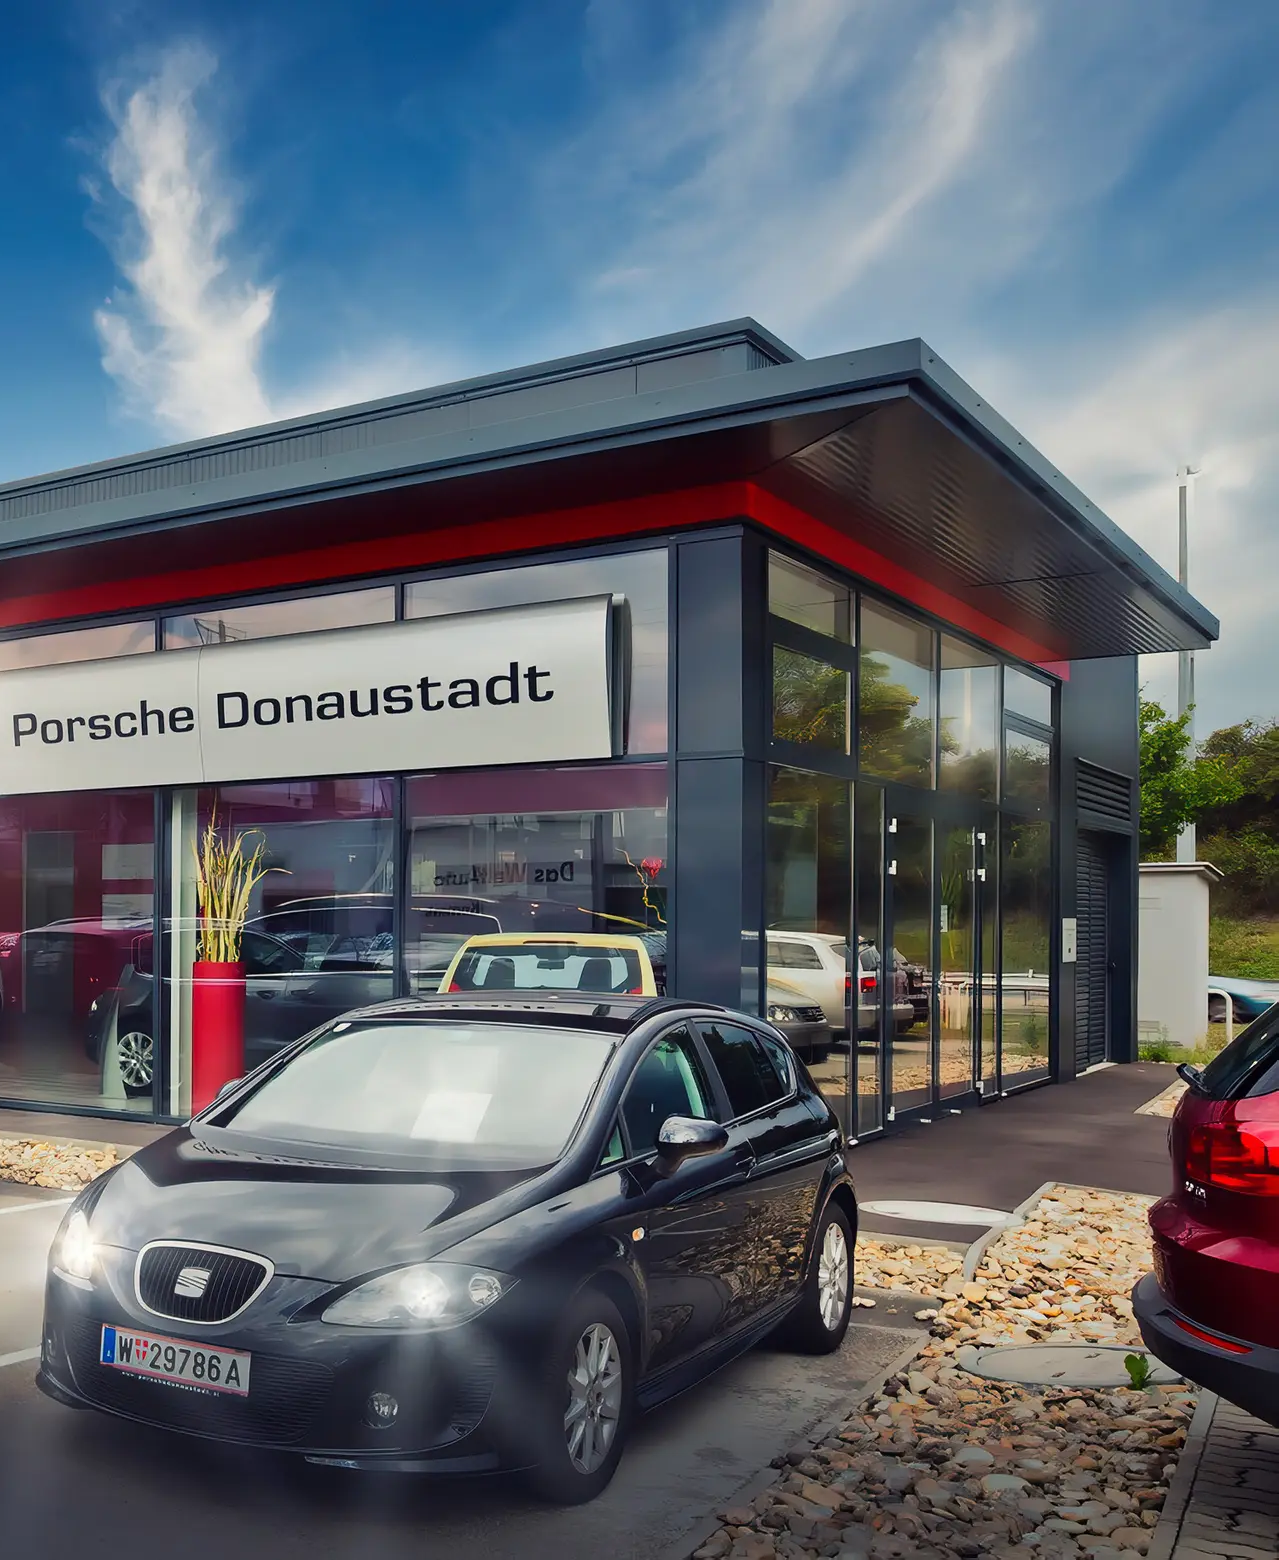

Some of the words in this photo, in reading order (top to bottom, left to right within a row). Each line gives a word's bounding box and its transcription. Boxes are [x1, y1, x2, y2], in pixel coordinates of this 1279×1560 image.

[12, 699, 196, 747] Porsche
[216, 660, 555, 730] Donaustadt
[118, 1335, 134, 1364] W
